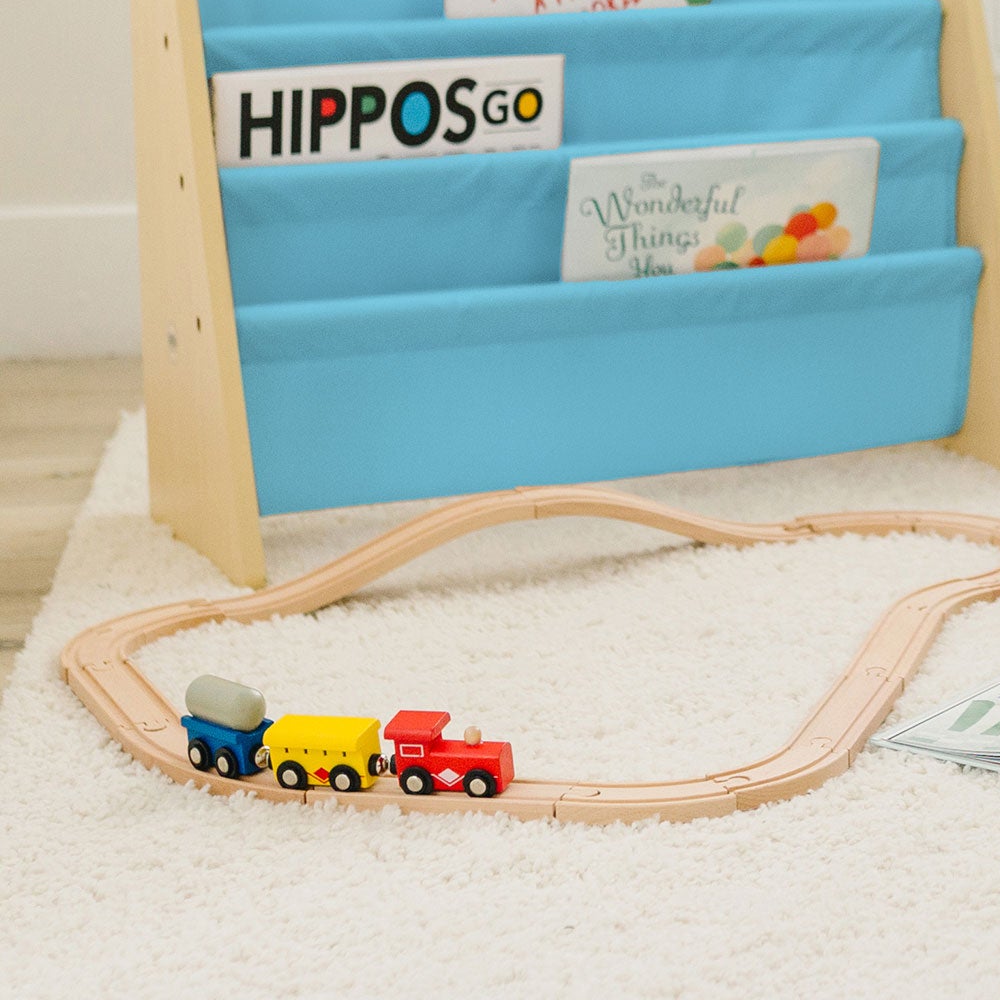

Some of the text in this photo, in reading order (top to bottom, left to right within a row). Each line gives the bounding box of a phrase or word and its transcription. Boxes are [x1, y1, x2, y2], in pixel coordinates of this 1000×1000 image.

[240, 78, 543, 160] HIPPOS GO
[580, 183, 747, 227] Wonderful
[603, 221, 701, 262] Things
